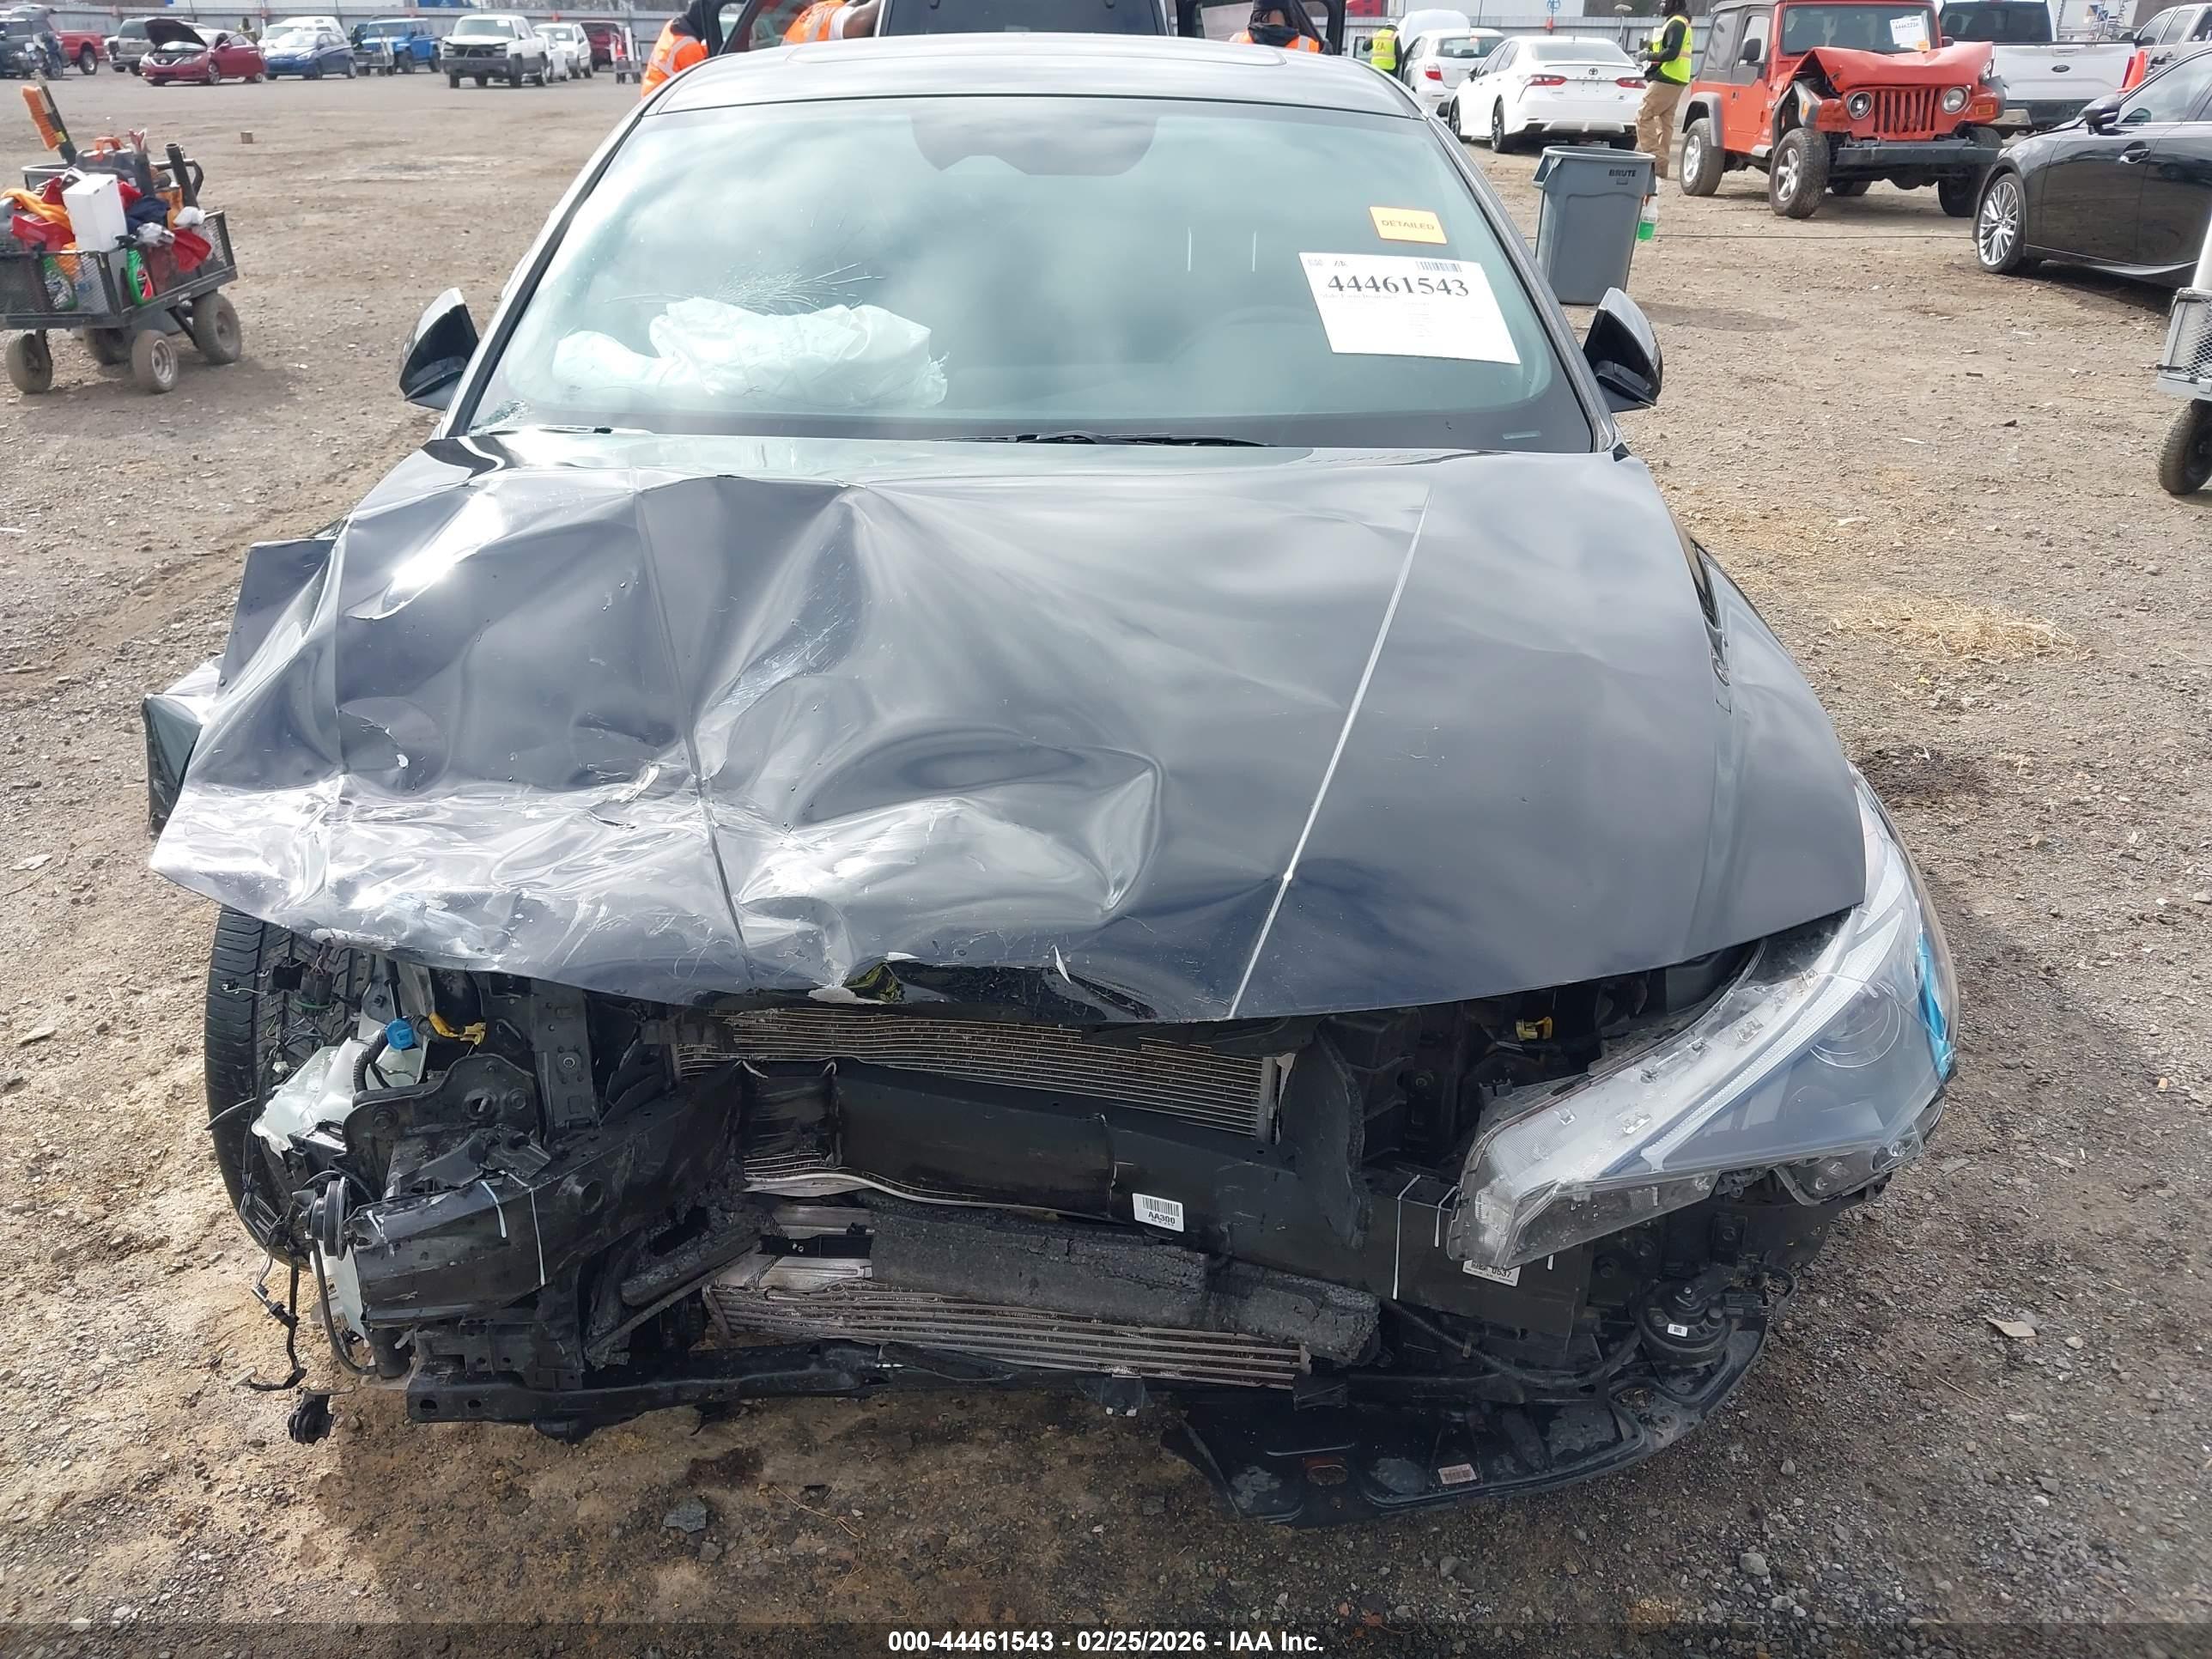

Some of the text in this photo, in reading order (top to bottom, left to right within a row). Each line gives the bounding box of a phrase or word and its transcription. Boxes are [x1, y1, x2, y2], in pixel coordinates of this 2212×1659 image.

[1608, 168, 1637, 178] BRUTE
[1381, 220, 1435, 230] DETAILED
[1327, 274, 1469, 297] 44461543
[1148, 1211, 1176, 1224] AA300
